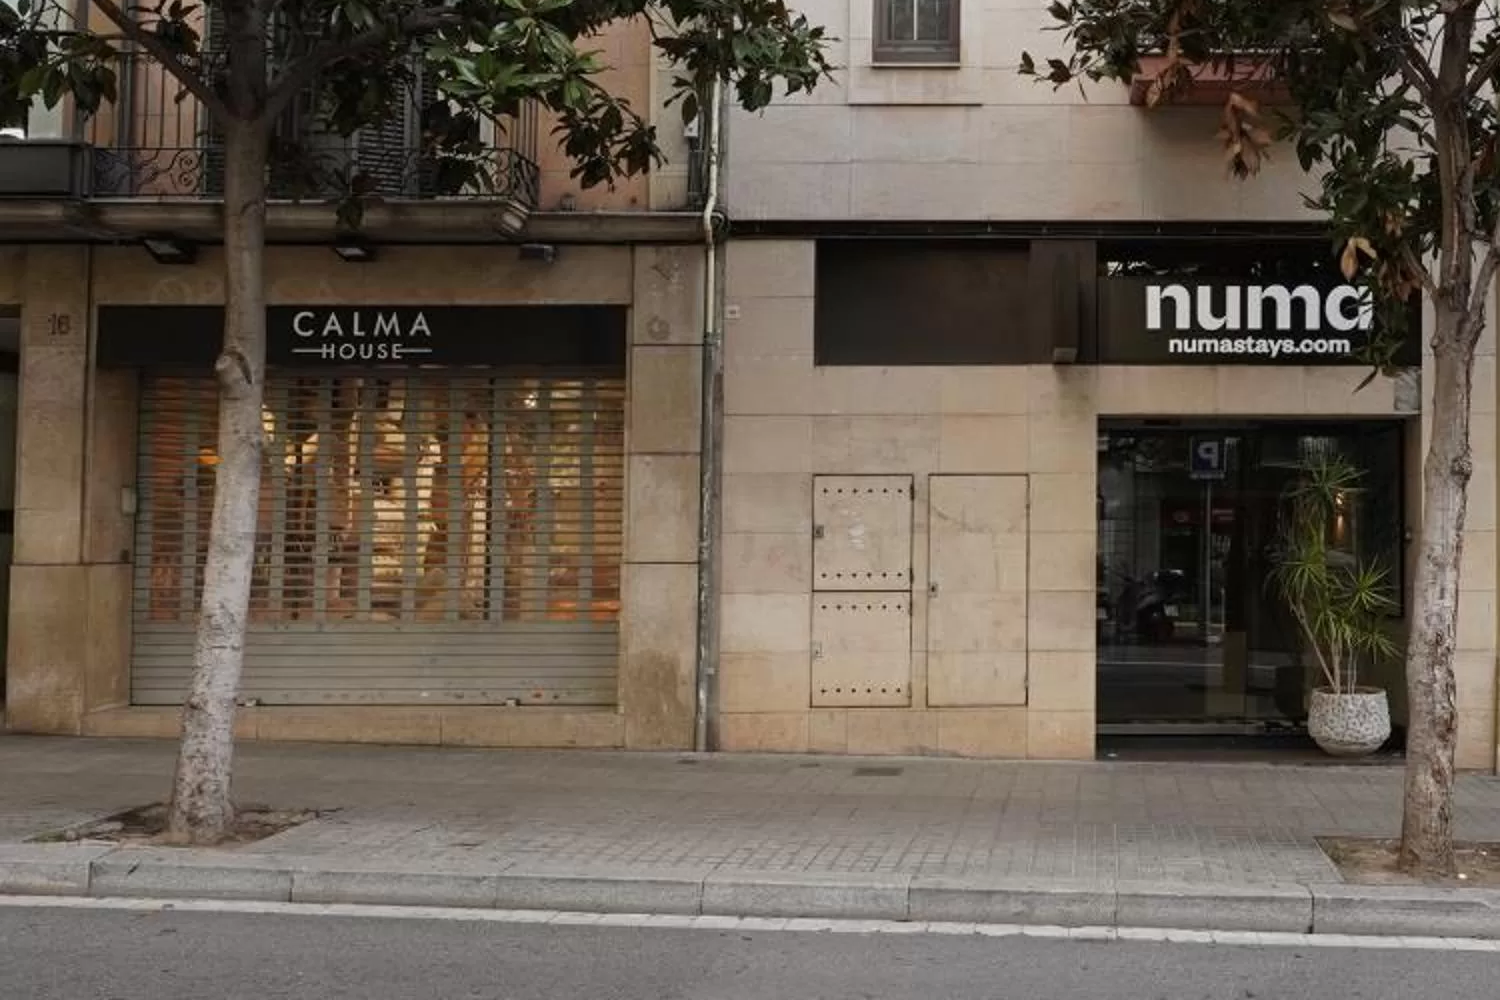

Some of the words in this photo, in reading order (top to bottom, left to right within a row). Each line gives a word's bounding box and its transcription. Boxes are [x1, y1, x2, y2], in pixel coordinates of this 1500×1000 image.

[1146, 284, 1373, 330] numa
[293, 311, 431, 336] CALMA
[321, 343, 403, 359] HOUSE
[1169, 336, 1351, 357] numastays.com
